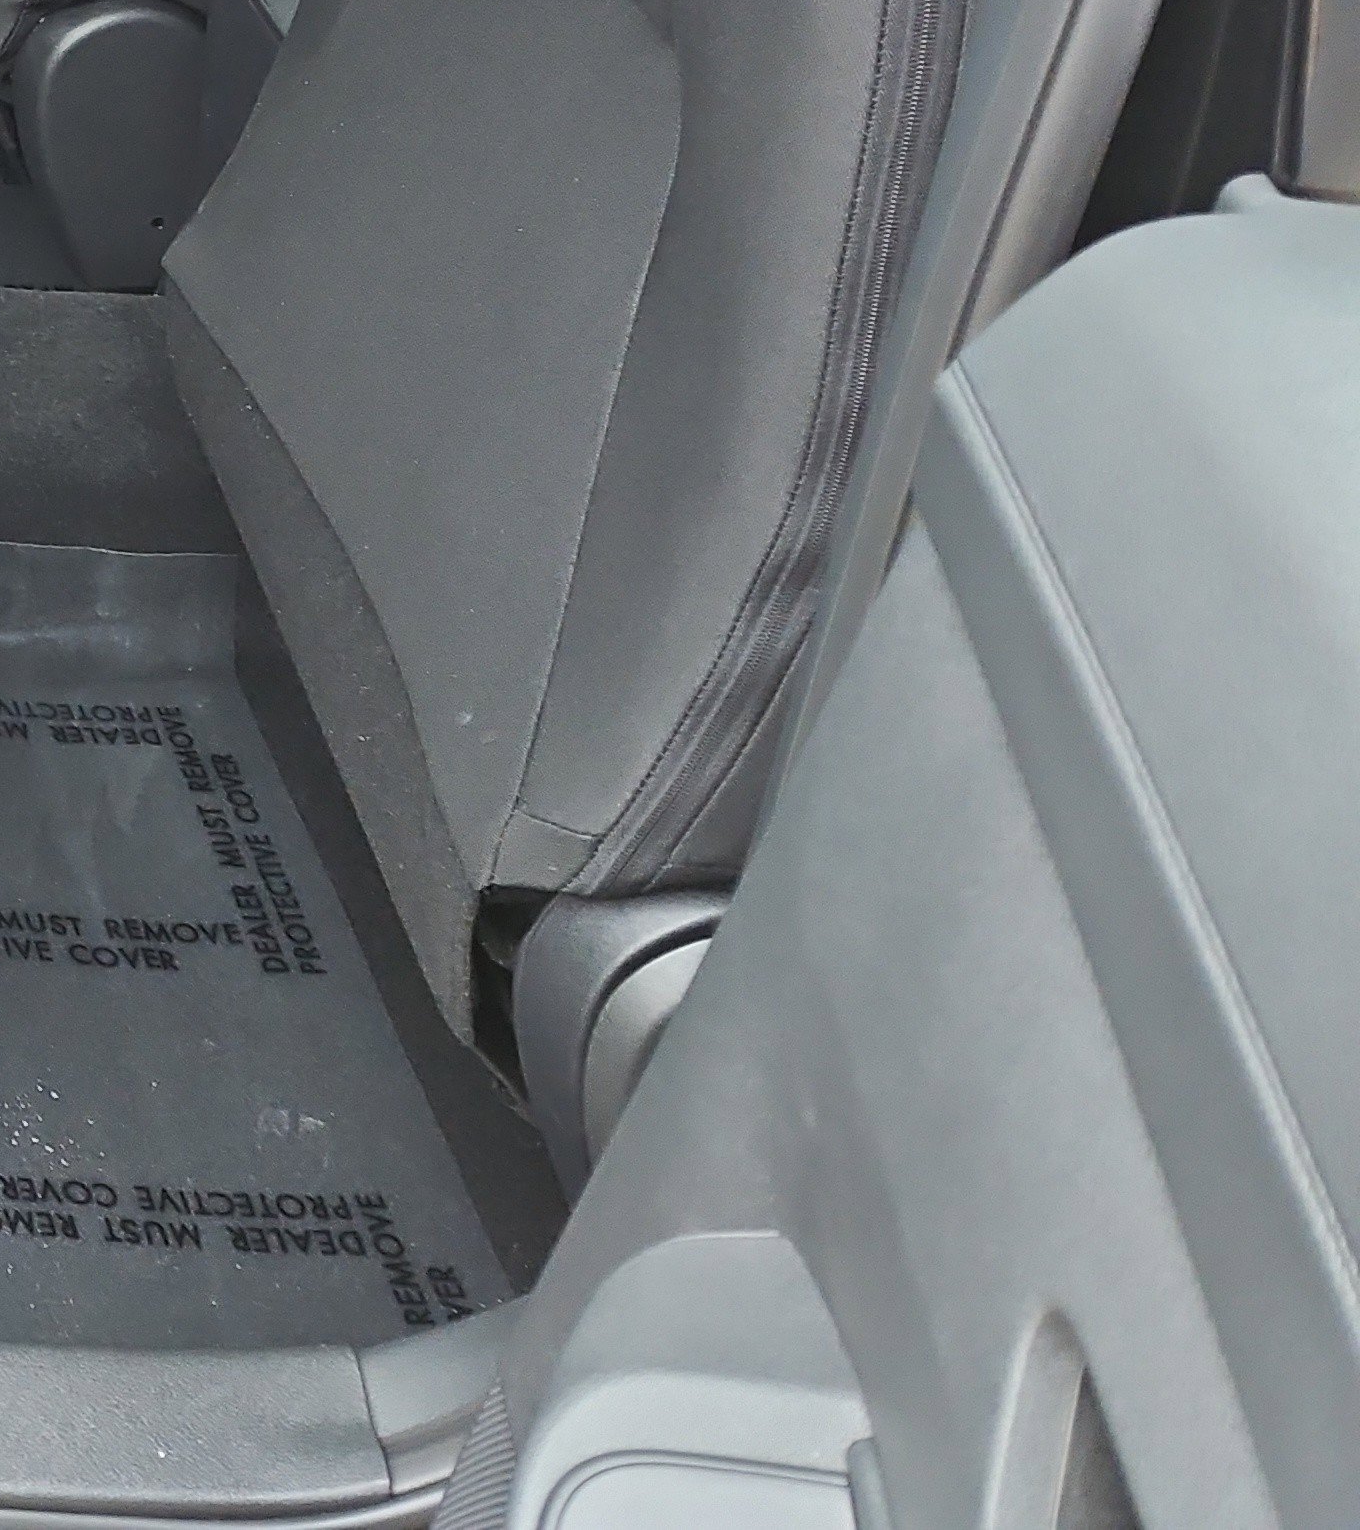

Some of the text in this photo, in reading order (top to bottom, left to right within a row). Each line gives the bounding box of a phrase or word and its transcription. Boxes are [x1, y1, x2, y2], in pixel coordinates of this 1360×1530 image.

[49, 721, 163, 746] DEALER
[157, 706, 290, 974] DEALER MUST REMOVE
[211, 754, 327, 975] PROTECTIVE COVER
[105, 916, 245, 947] REMOVE
[68, 944, 181, 971] COVER
[133, 1184, 353, 1221] PROTECTIVE
[104, 1215, 202, 1251] MUST
[225, 1226, 368, 1258] DEALER
[355, 1191, 435, 1328] REMOVE
